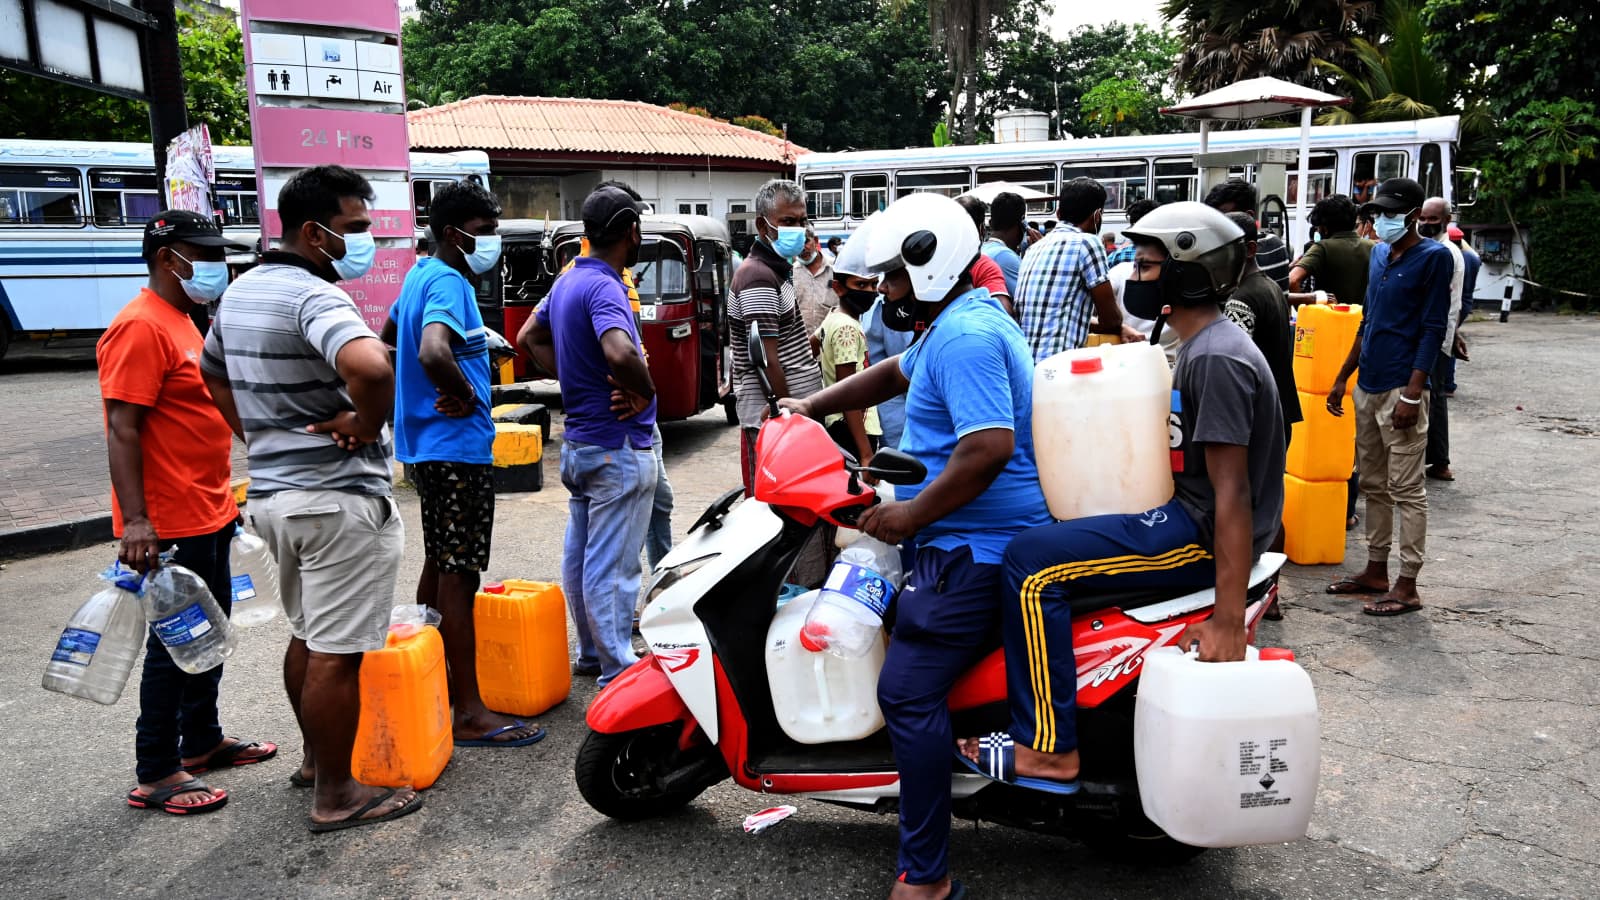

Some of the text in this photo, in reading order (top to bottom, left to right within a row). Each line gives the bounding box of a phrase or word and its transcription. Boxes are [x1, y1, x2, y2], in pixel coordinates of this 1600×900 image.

[373, 80, 393, 94] Air
[301, 128, 374, 150] 24 Hrs
[349, 289, 368, 301] TD.
